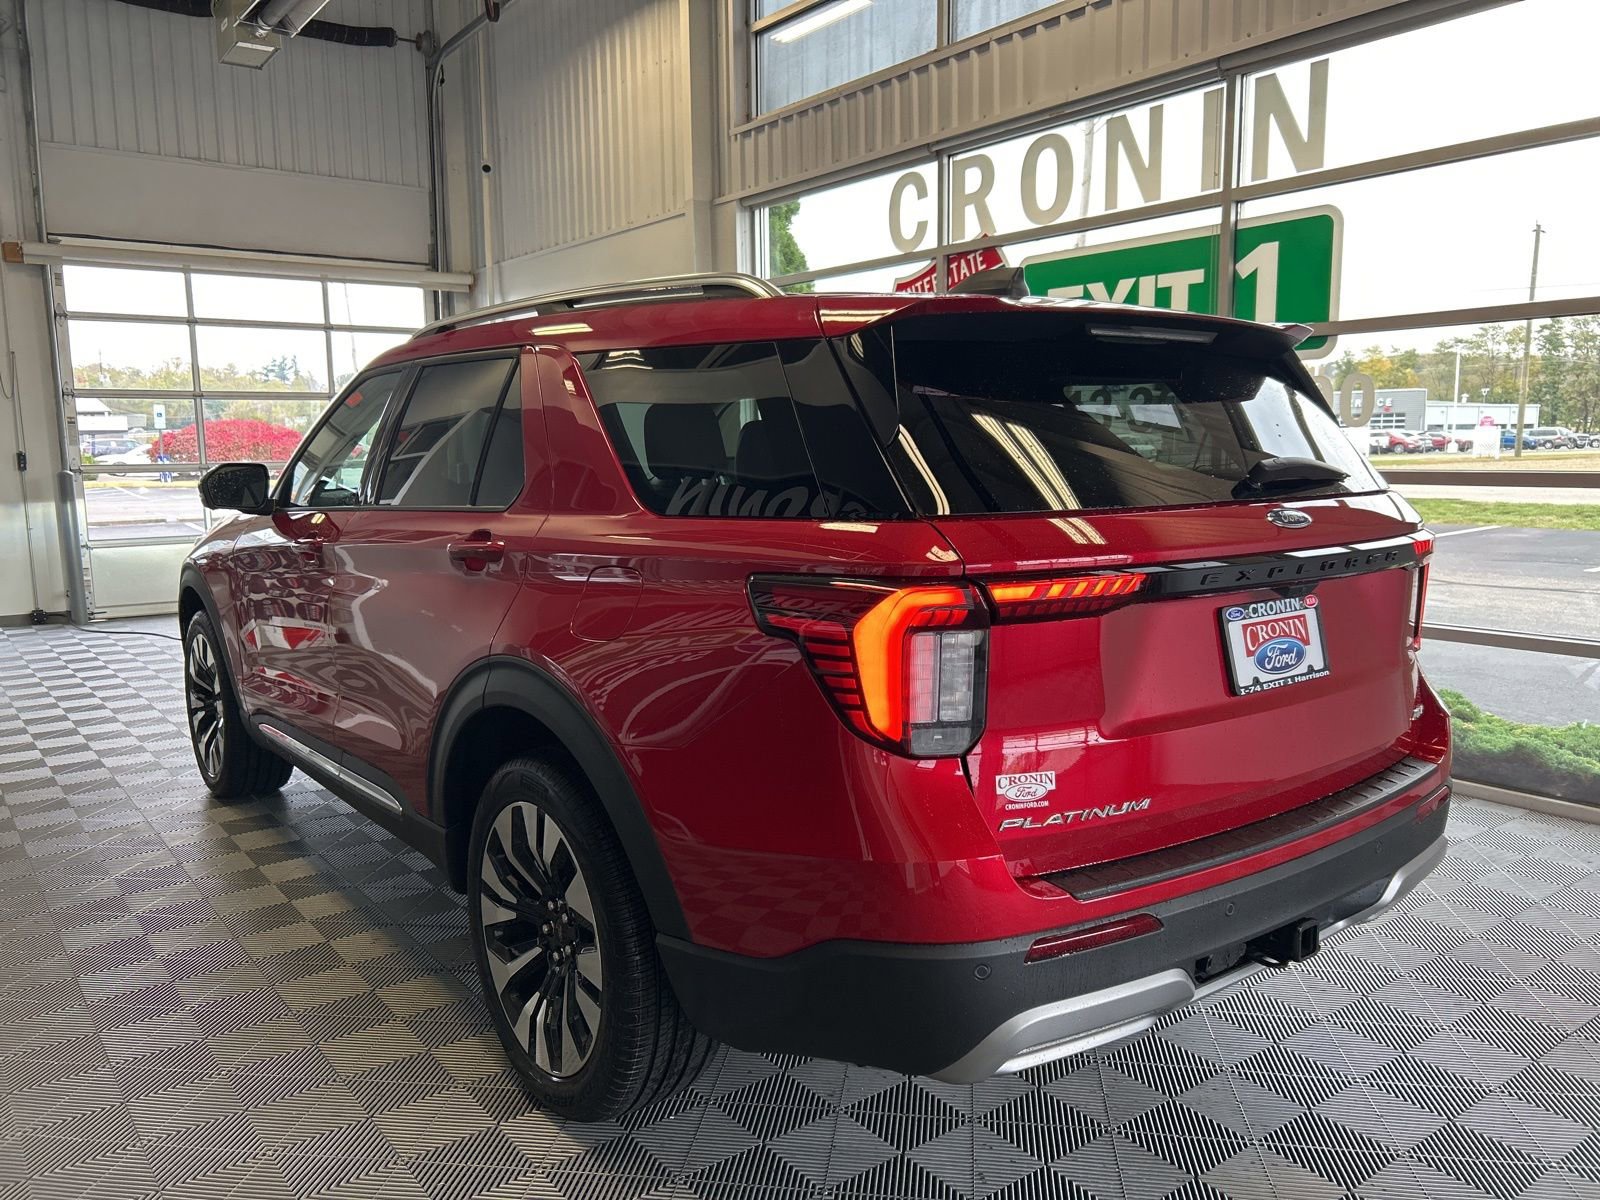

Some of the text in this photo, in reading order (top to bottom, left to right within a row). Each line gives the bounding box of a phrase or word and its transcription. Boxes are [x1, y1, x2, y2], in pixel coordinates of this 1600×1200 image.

[889, 57, 1330, 254] CRONIN
[1048, 241, 1279, 323] XIT 1
[1200, 550, 1399, 587] EXPLORER
[1249, 597, 1301, 618] CRONIN
[1246, 618, 1307, 651] CRONIN
[1265, 644, 1298, 670] Ford
[1240, 685, 1262, 696] I-74
[1263, 680, 1286, 690] EXIT
[1295, 670, 1331, 682] Harrison
[998, 773, 1053, 790] CRONIN
[1015, 786, 1038, 798] Ford
[998, 797, 1153, 833] PLATINUM
[1005, 800, 1050, 811] CRONINFORD.COM
